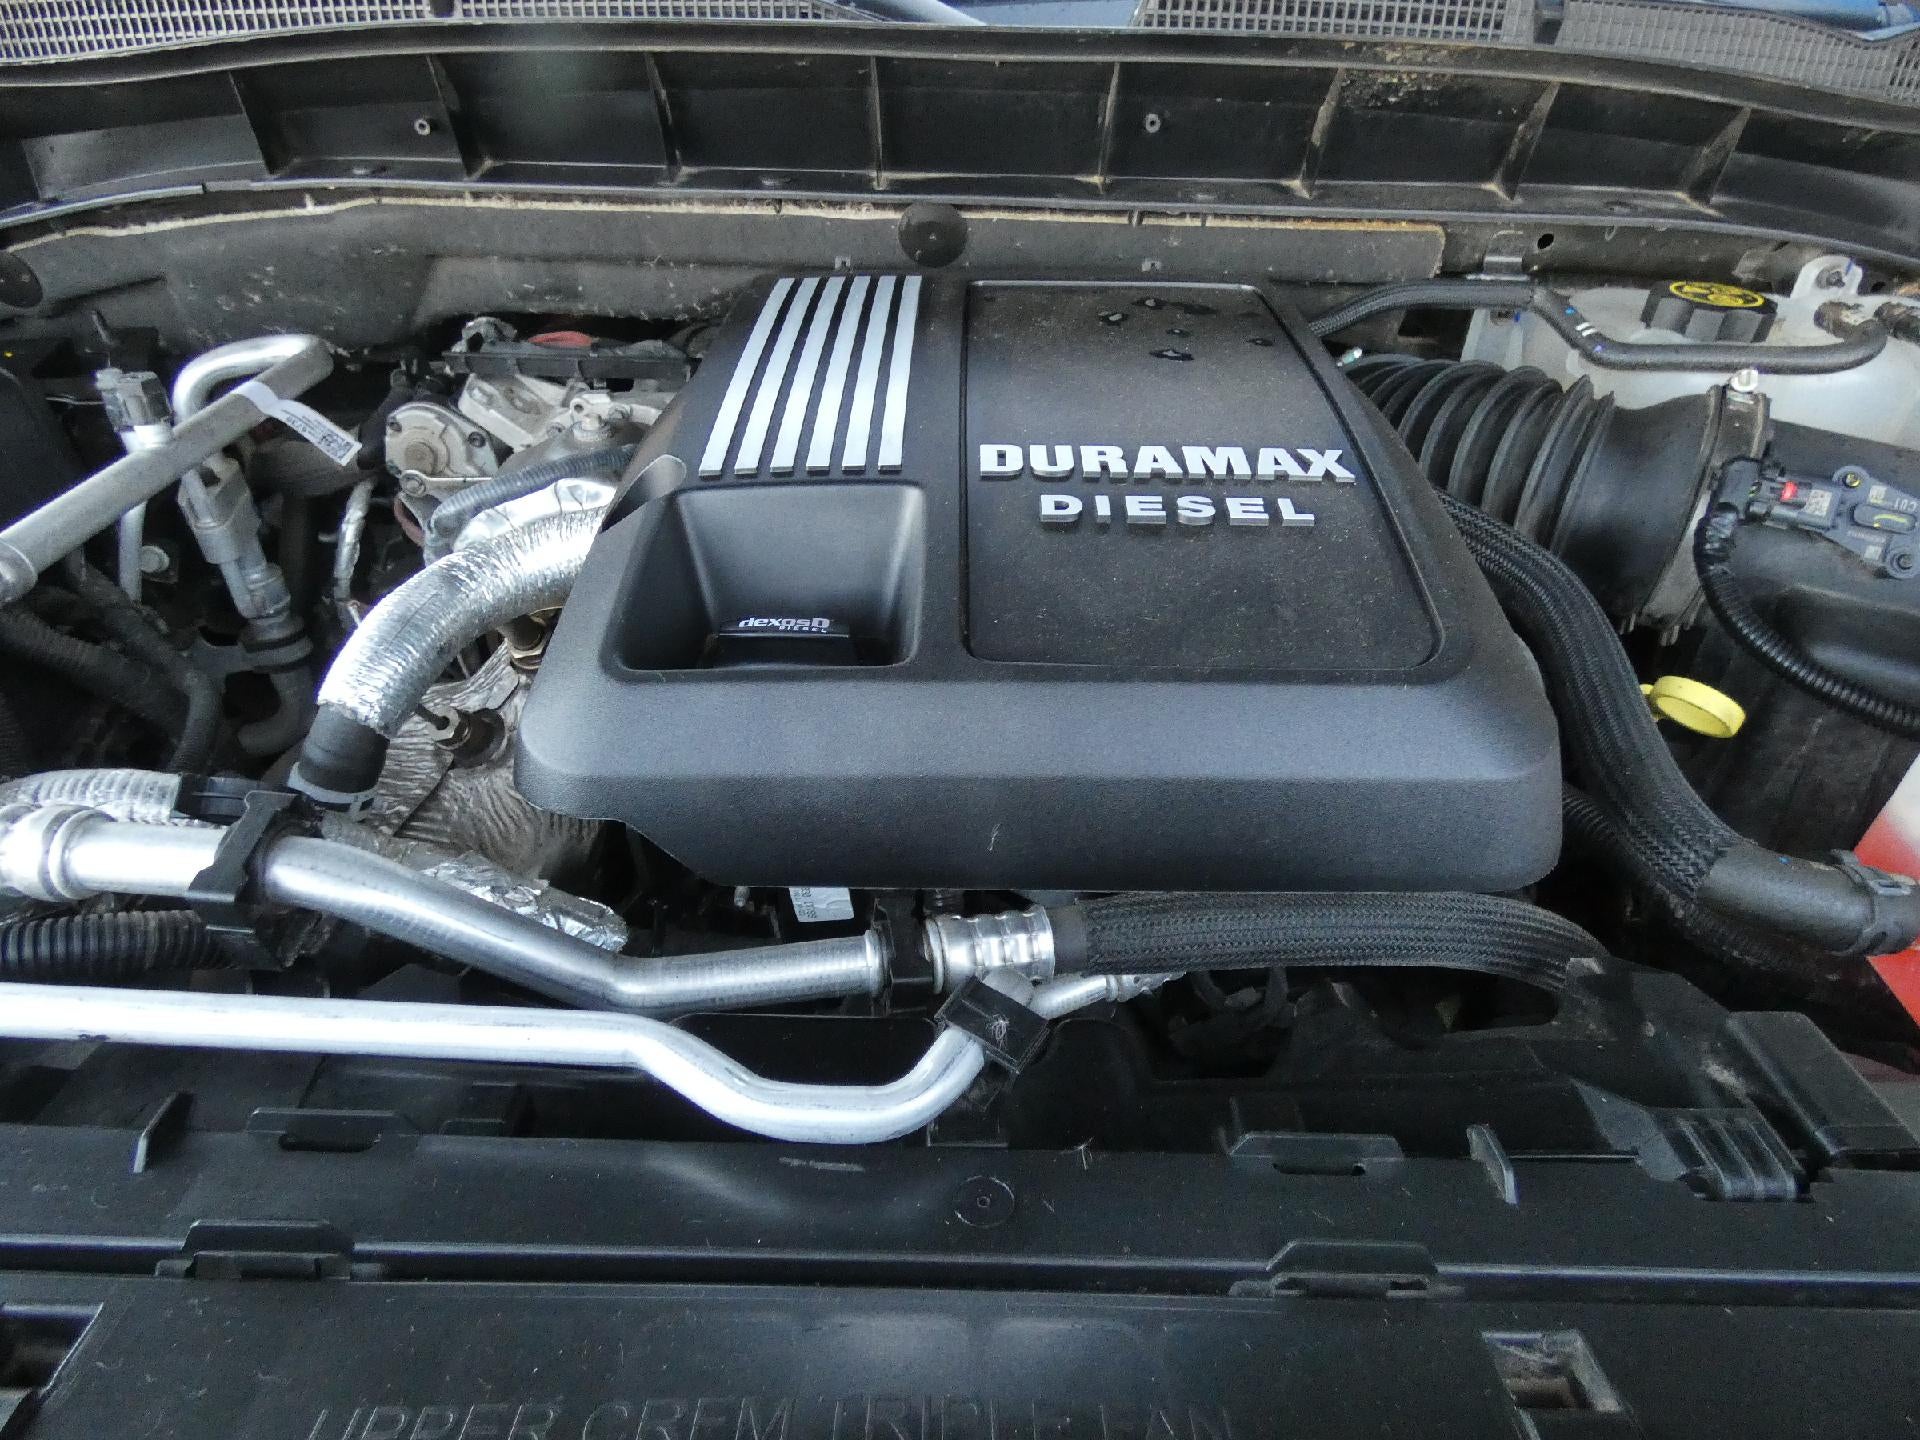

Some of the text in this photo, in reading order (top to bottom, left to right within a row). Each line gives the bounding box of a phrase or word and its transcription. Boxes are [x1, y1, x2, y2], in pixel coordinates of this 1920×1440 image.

[980, 444, 1355, 483] DURAMAX
[1040, 494, 1315, 527] DIESEL
[779, 625, 827, 633] DIESEL
